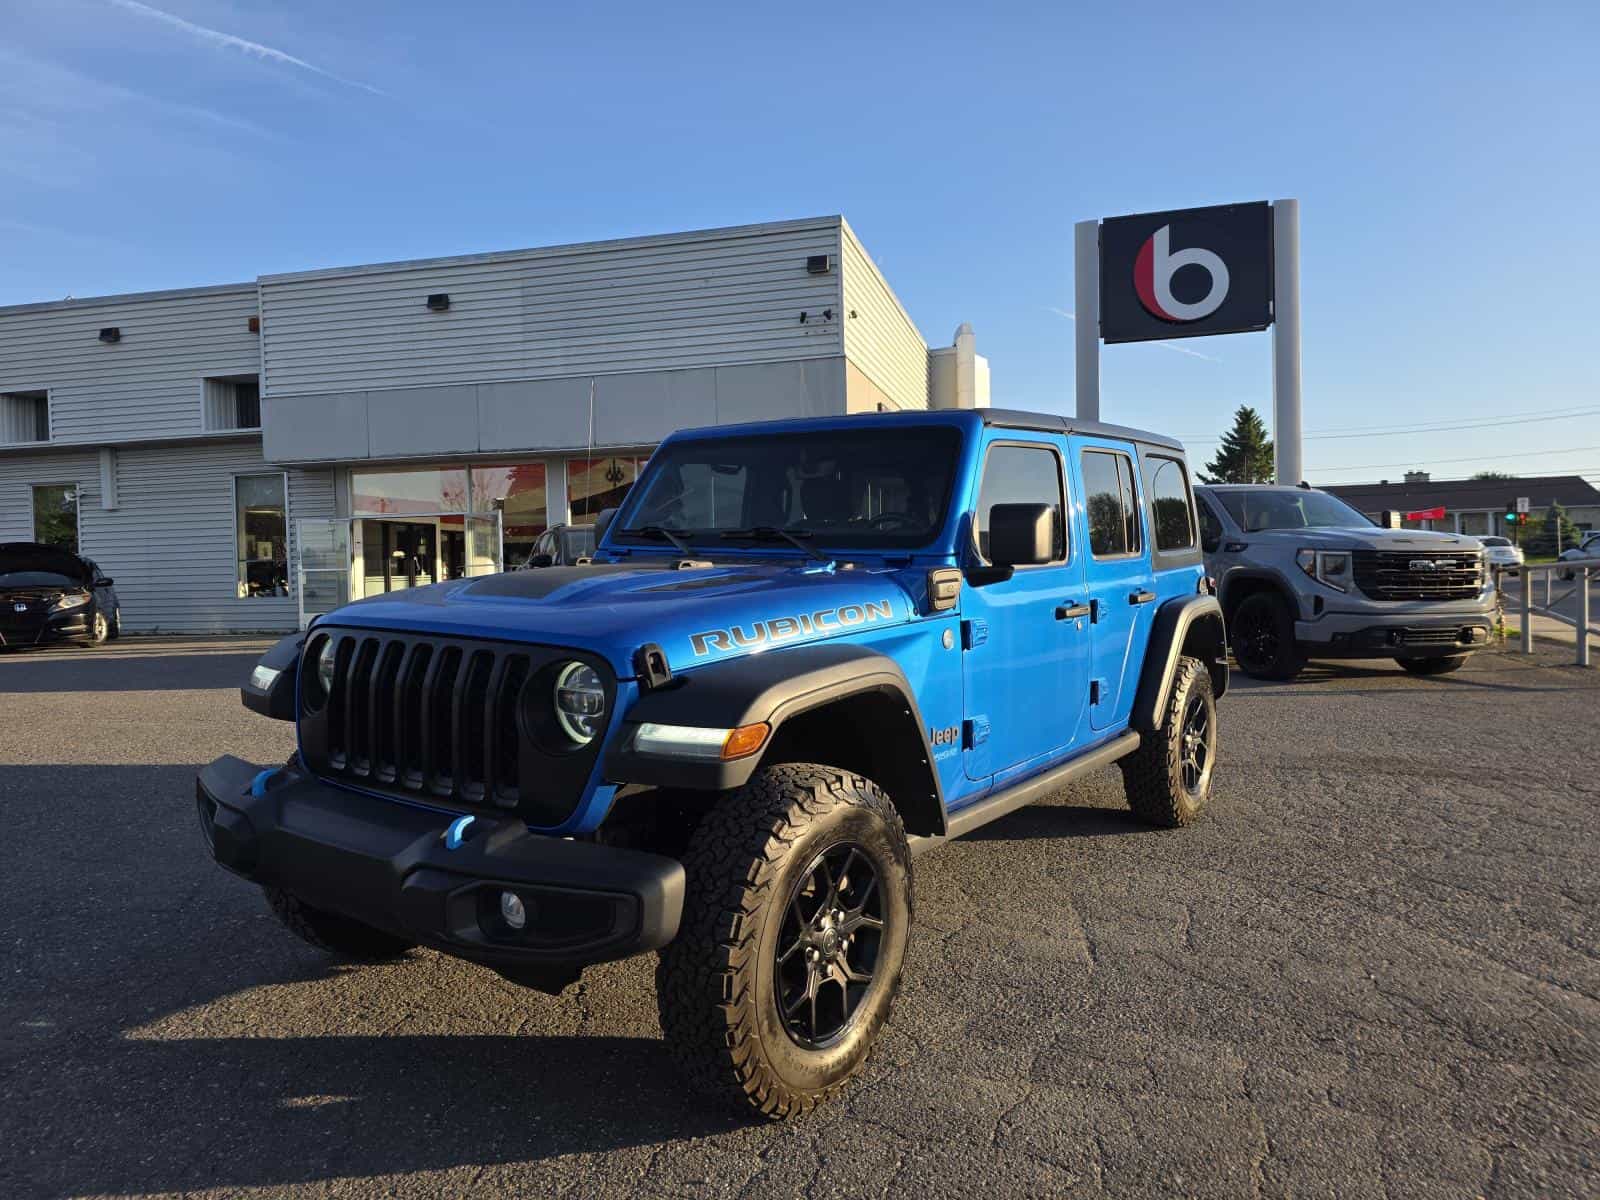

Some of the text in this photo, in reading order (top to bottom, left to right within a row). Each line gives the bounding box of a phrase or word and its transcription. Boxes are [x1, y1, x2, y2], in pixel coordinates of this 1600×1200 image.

[1148, 223, 1230, 321] b
[689, 599, 894, 656] RUBICON
[930, 726, 959, 746] Jeep
